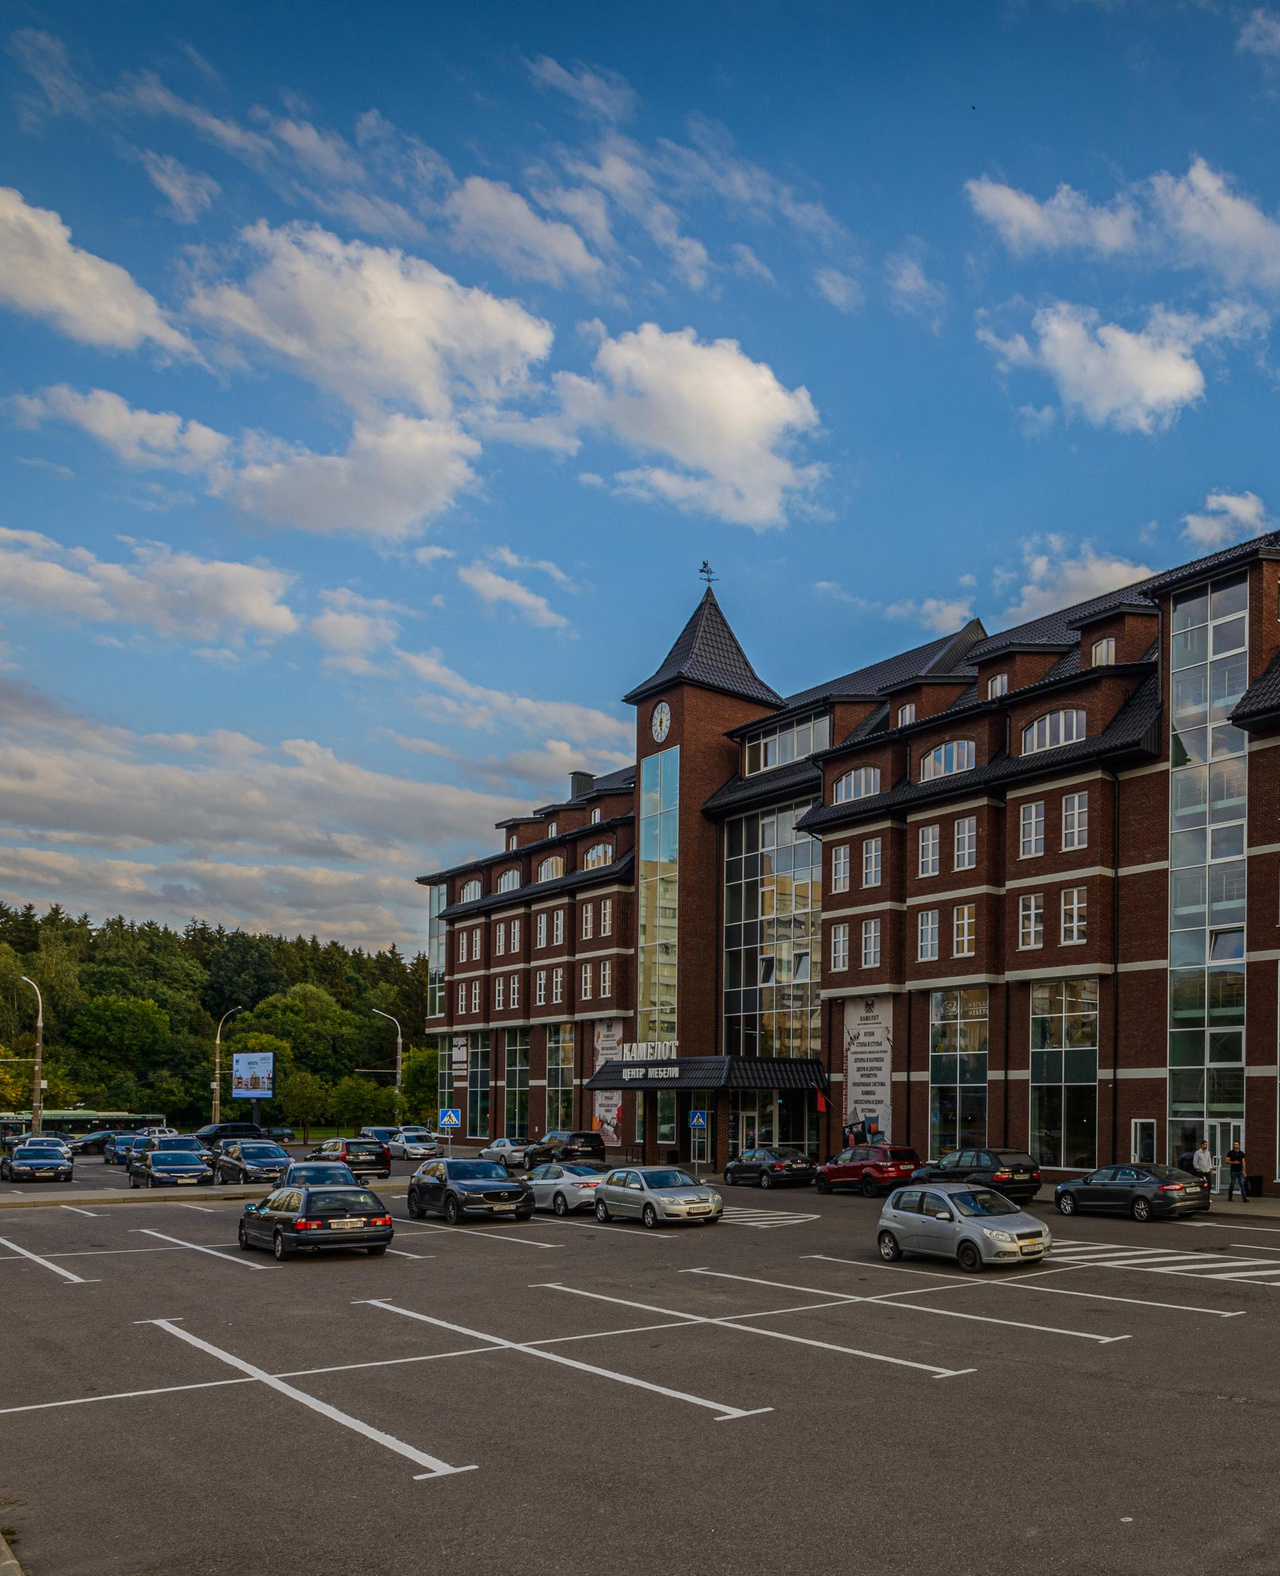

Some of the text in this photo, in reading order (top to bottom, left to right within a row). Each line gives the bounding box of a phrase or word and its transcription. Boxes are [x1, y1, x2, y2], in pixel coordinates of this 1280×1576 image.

[622, 1040, 679, 1061] КАМЕЛОТ
[622, 1067, 680, 1081] ЦЕНТР МЕБЕЛИ
